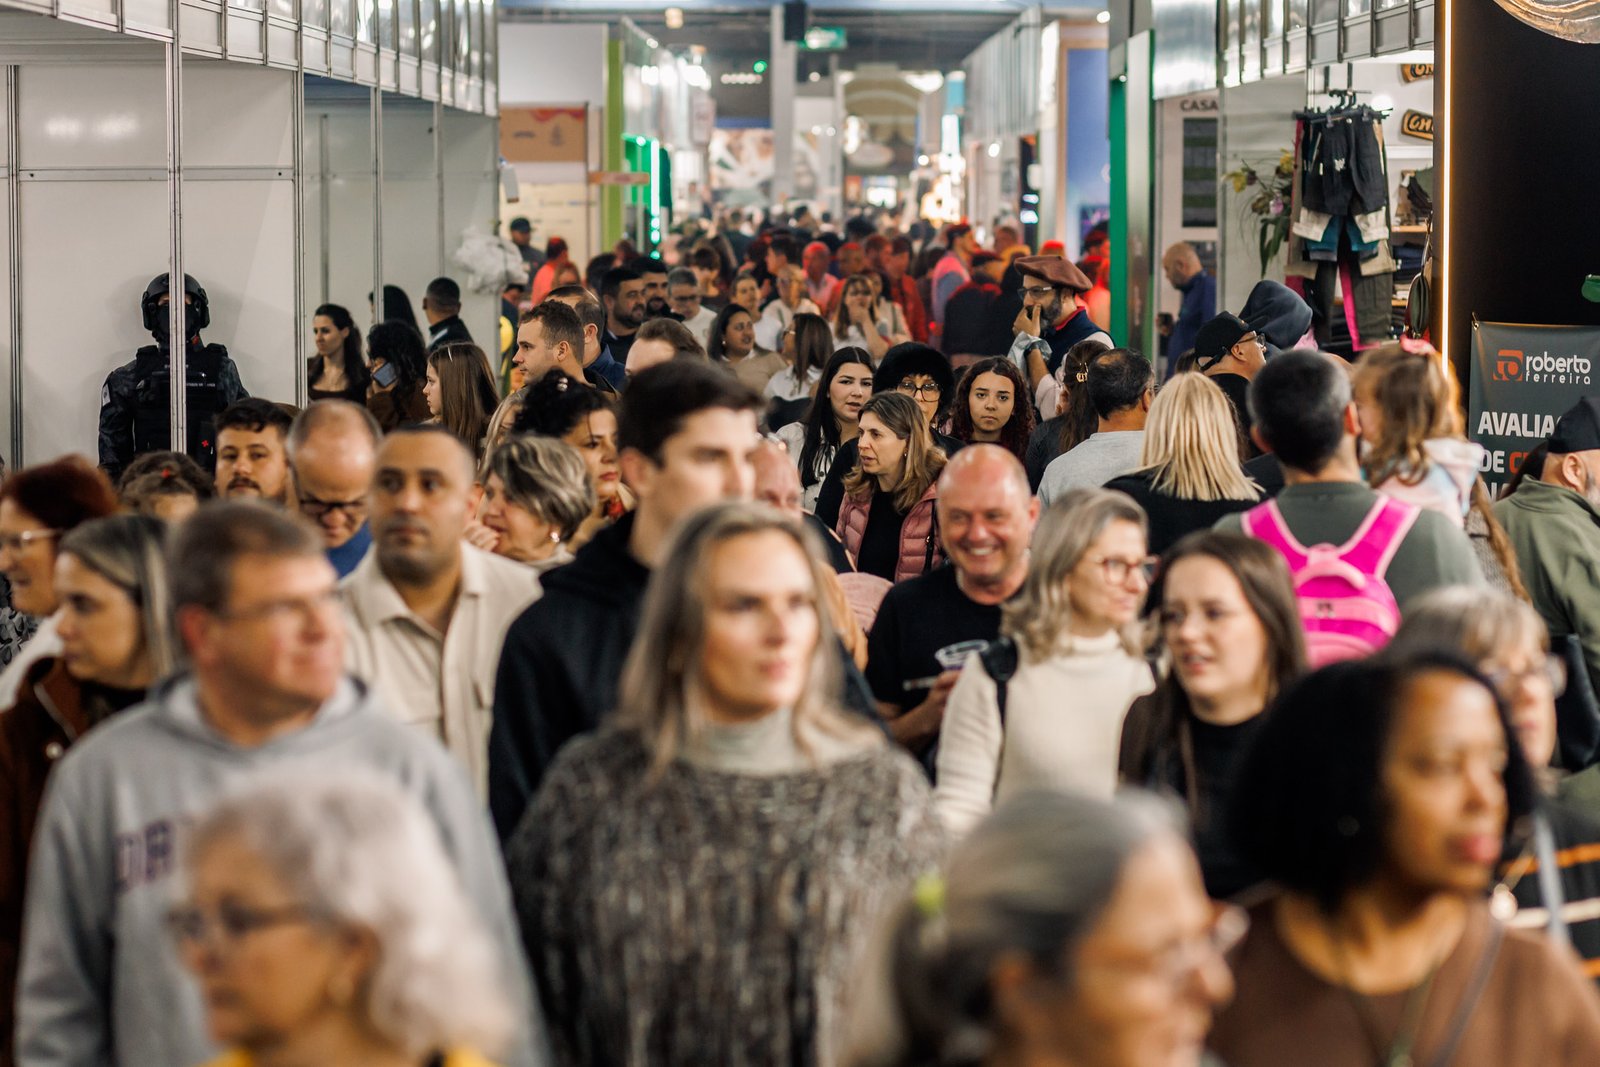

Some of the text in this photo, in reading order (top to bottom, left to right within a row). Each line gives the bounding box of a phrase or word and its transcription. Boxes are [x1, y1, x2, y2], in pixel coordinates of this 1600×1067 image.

[1180, 99, 1218, 111] CASA
[1525, 351, 1591, 374] roberto
[1525, 371, 1591, 385] ferreira
[1477, 411, 1561, 438] AVALIA
[1479, 449, 1505, 473] DE
